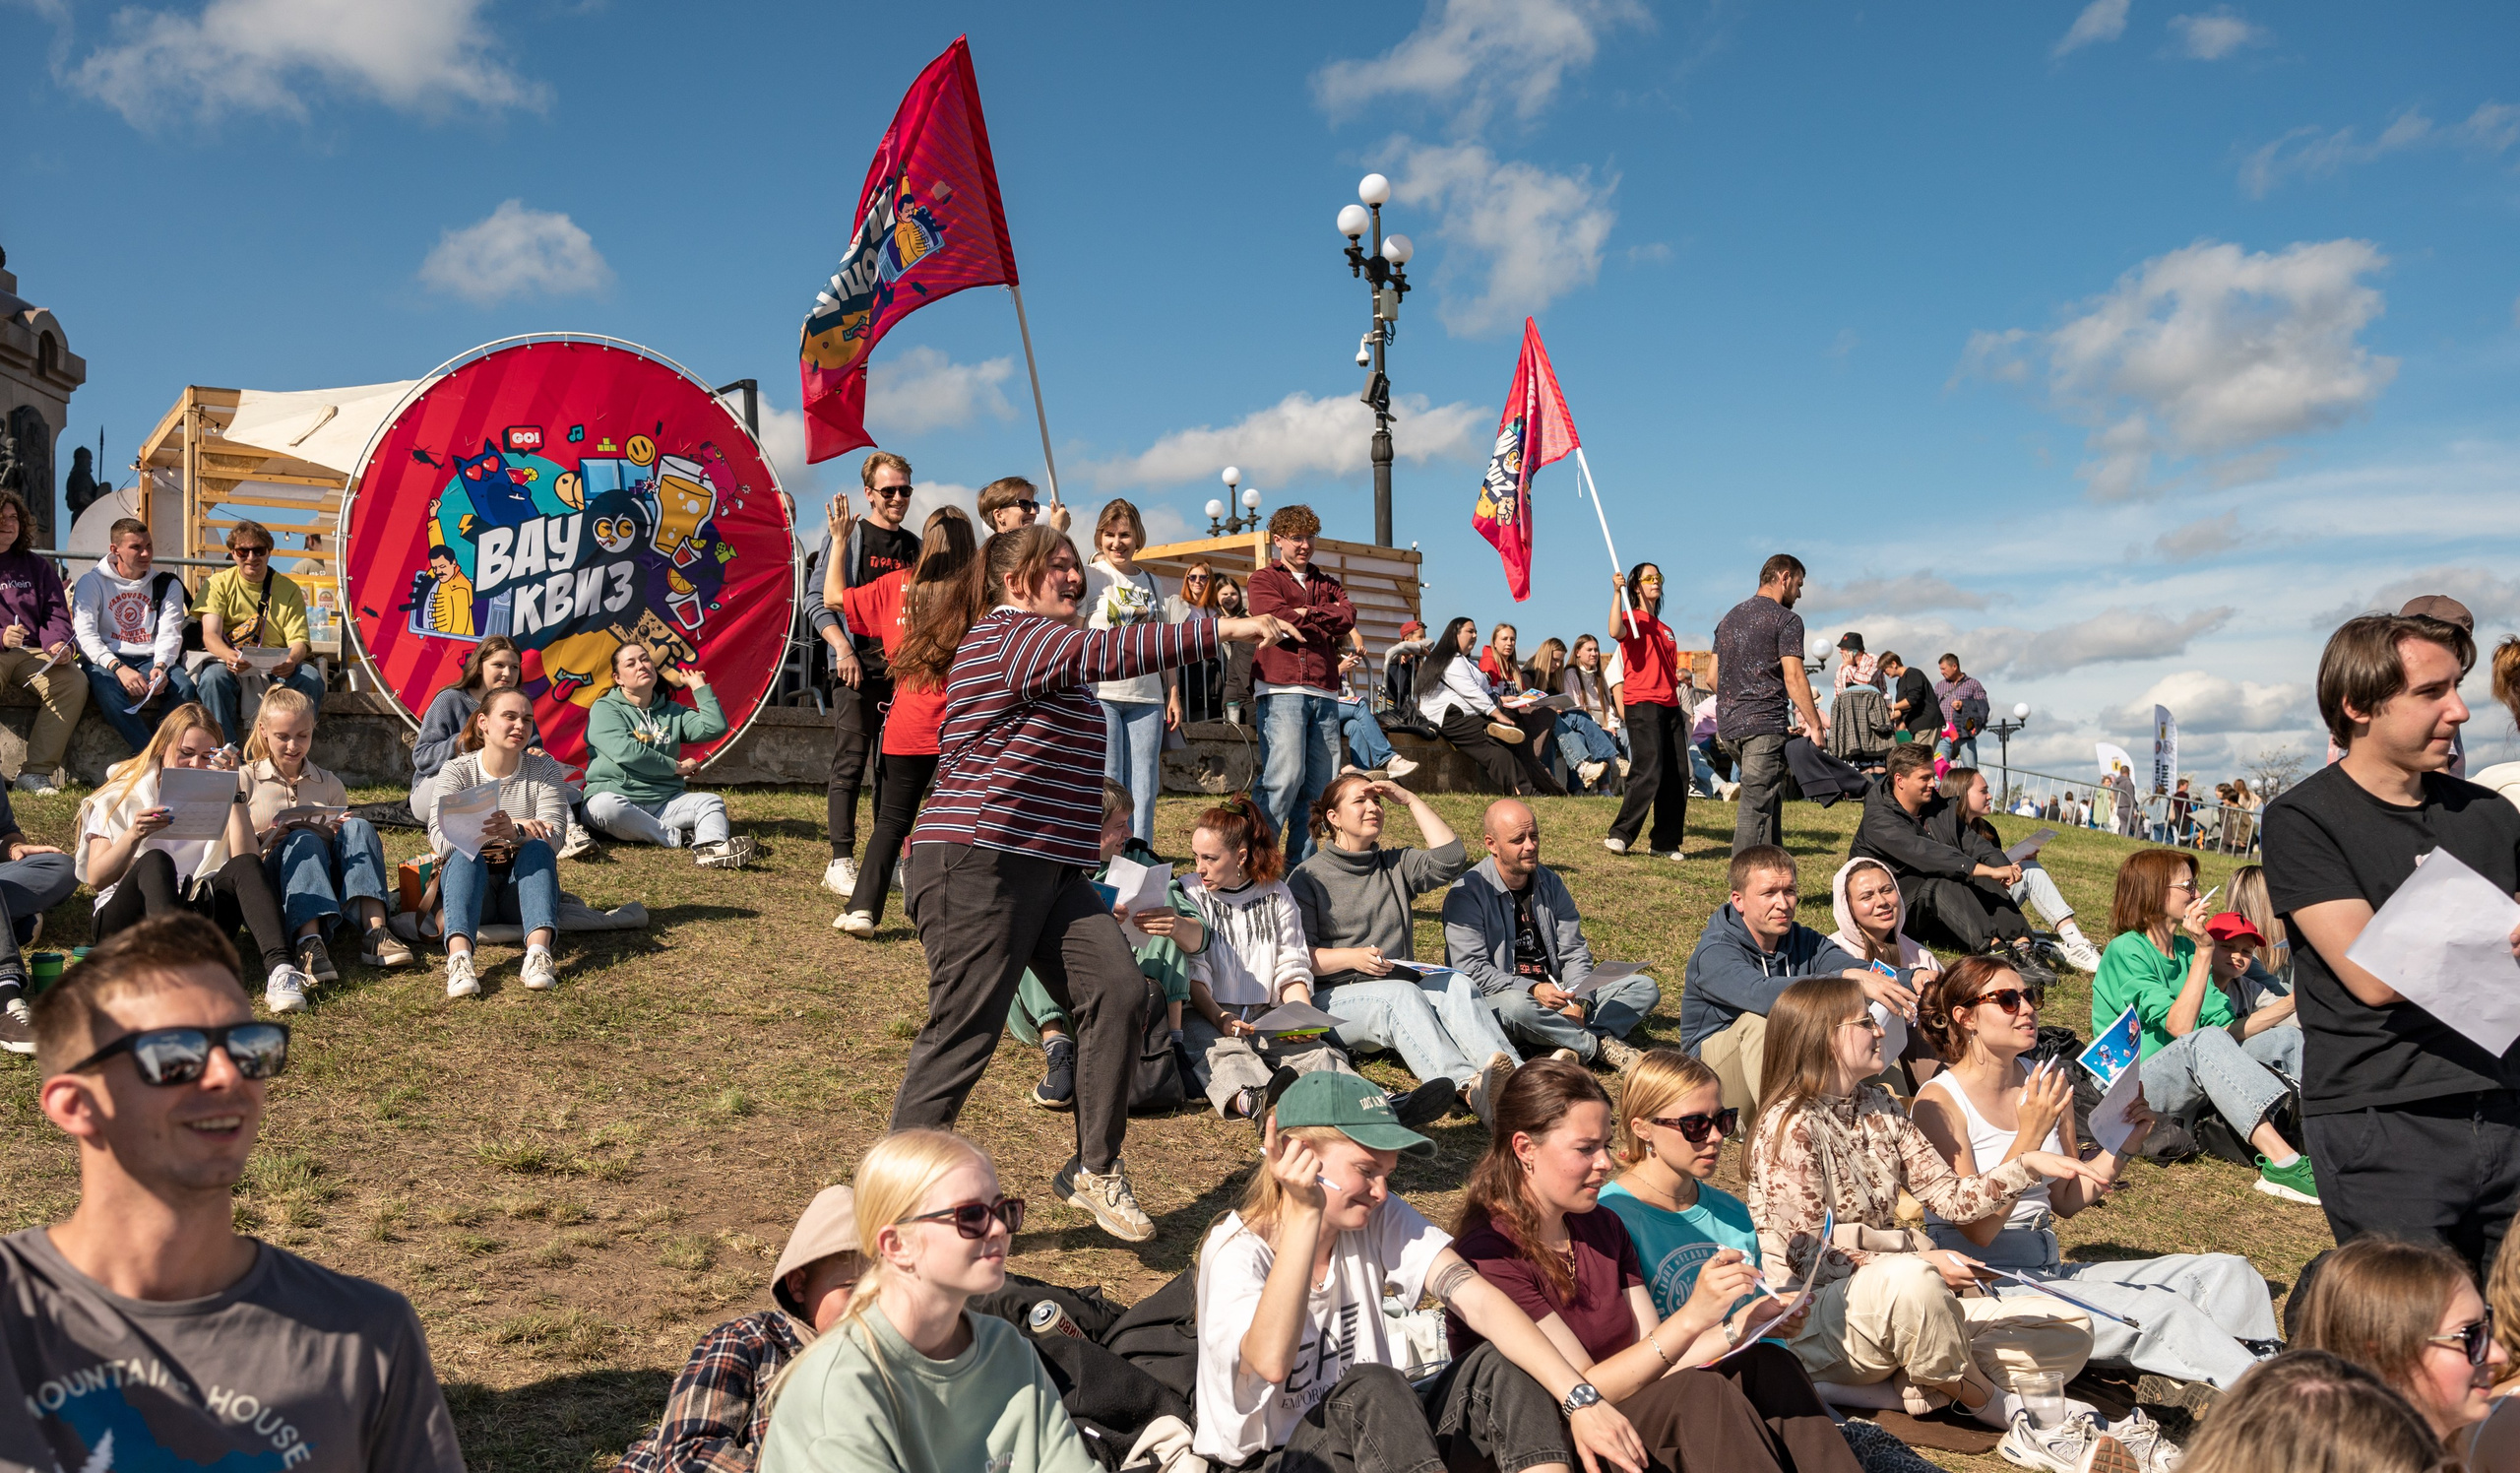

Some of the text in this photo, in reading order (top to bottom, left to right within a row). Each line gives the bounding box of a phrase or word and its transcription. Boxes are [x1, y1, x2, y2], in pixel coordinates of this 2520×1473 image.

[512, 431, 540, 444] GO!
[476, 512, 584, 592] ВАУ
[8, 580, 32, 589] Klein
[512, 560, 635, 637] КВИЗ
[1678, 1249, 1709, 1263] FLASH
[1657, 1264, 1674, 1296] LIGHT
[206, 1384, 312, 1470] HOUSE
